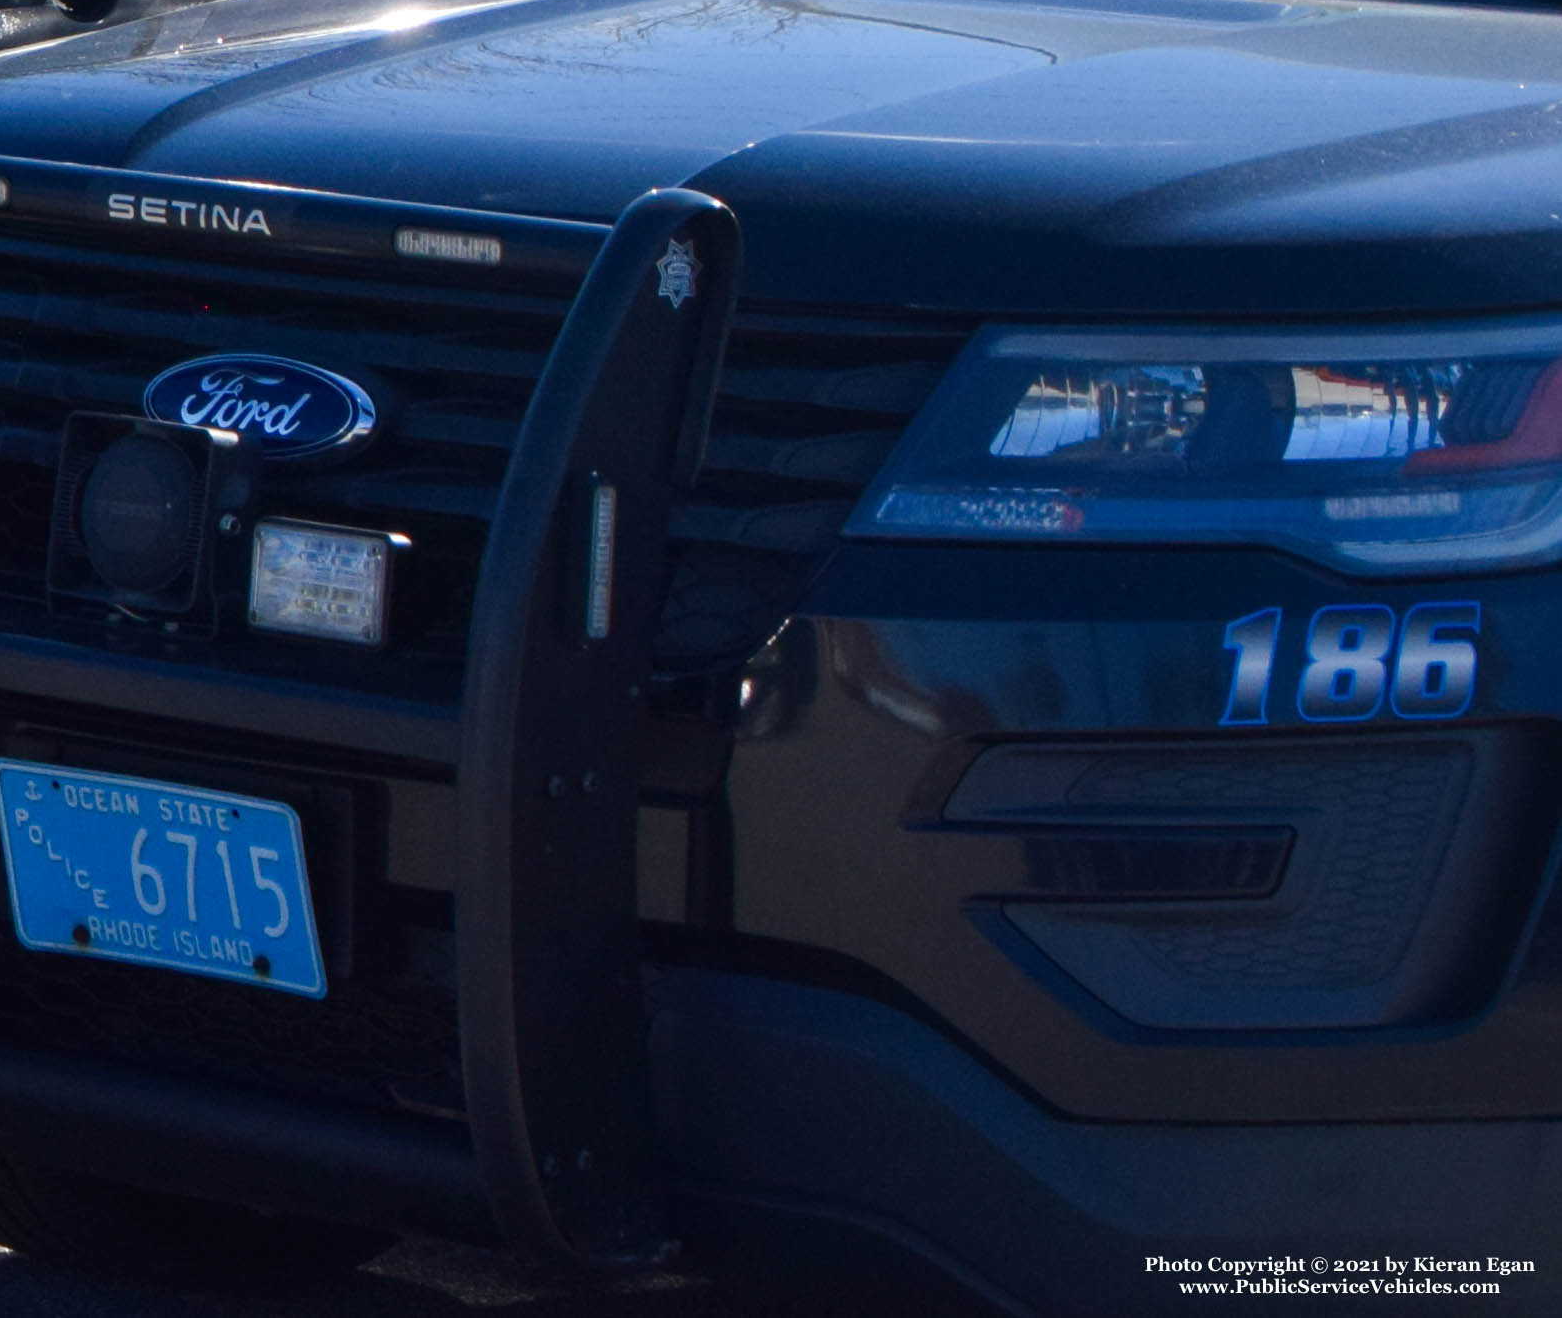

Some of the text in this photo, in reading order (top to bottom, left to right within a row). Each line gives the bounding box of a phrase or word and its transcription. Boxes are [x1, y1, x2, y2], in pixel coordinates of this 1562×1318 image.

[108, 193, 272, 236] SETINA
[180, 369, 312, 436] Ford
[1217, 599, 1482, 726] 186
[63, 784, 230, 832] OCEAN STATE
[14, 807, 111, 910] POLICE
[130, 827, 290, 938] 6715
[87, 915, 255, 968] RHODE ISLAND
